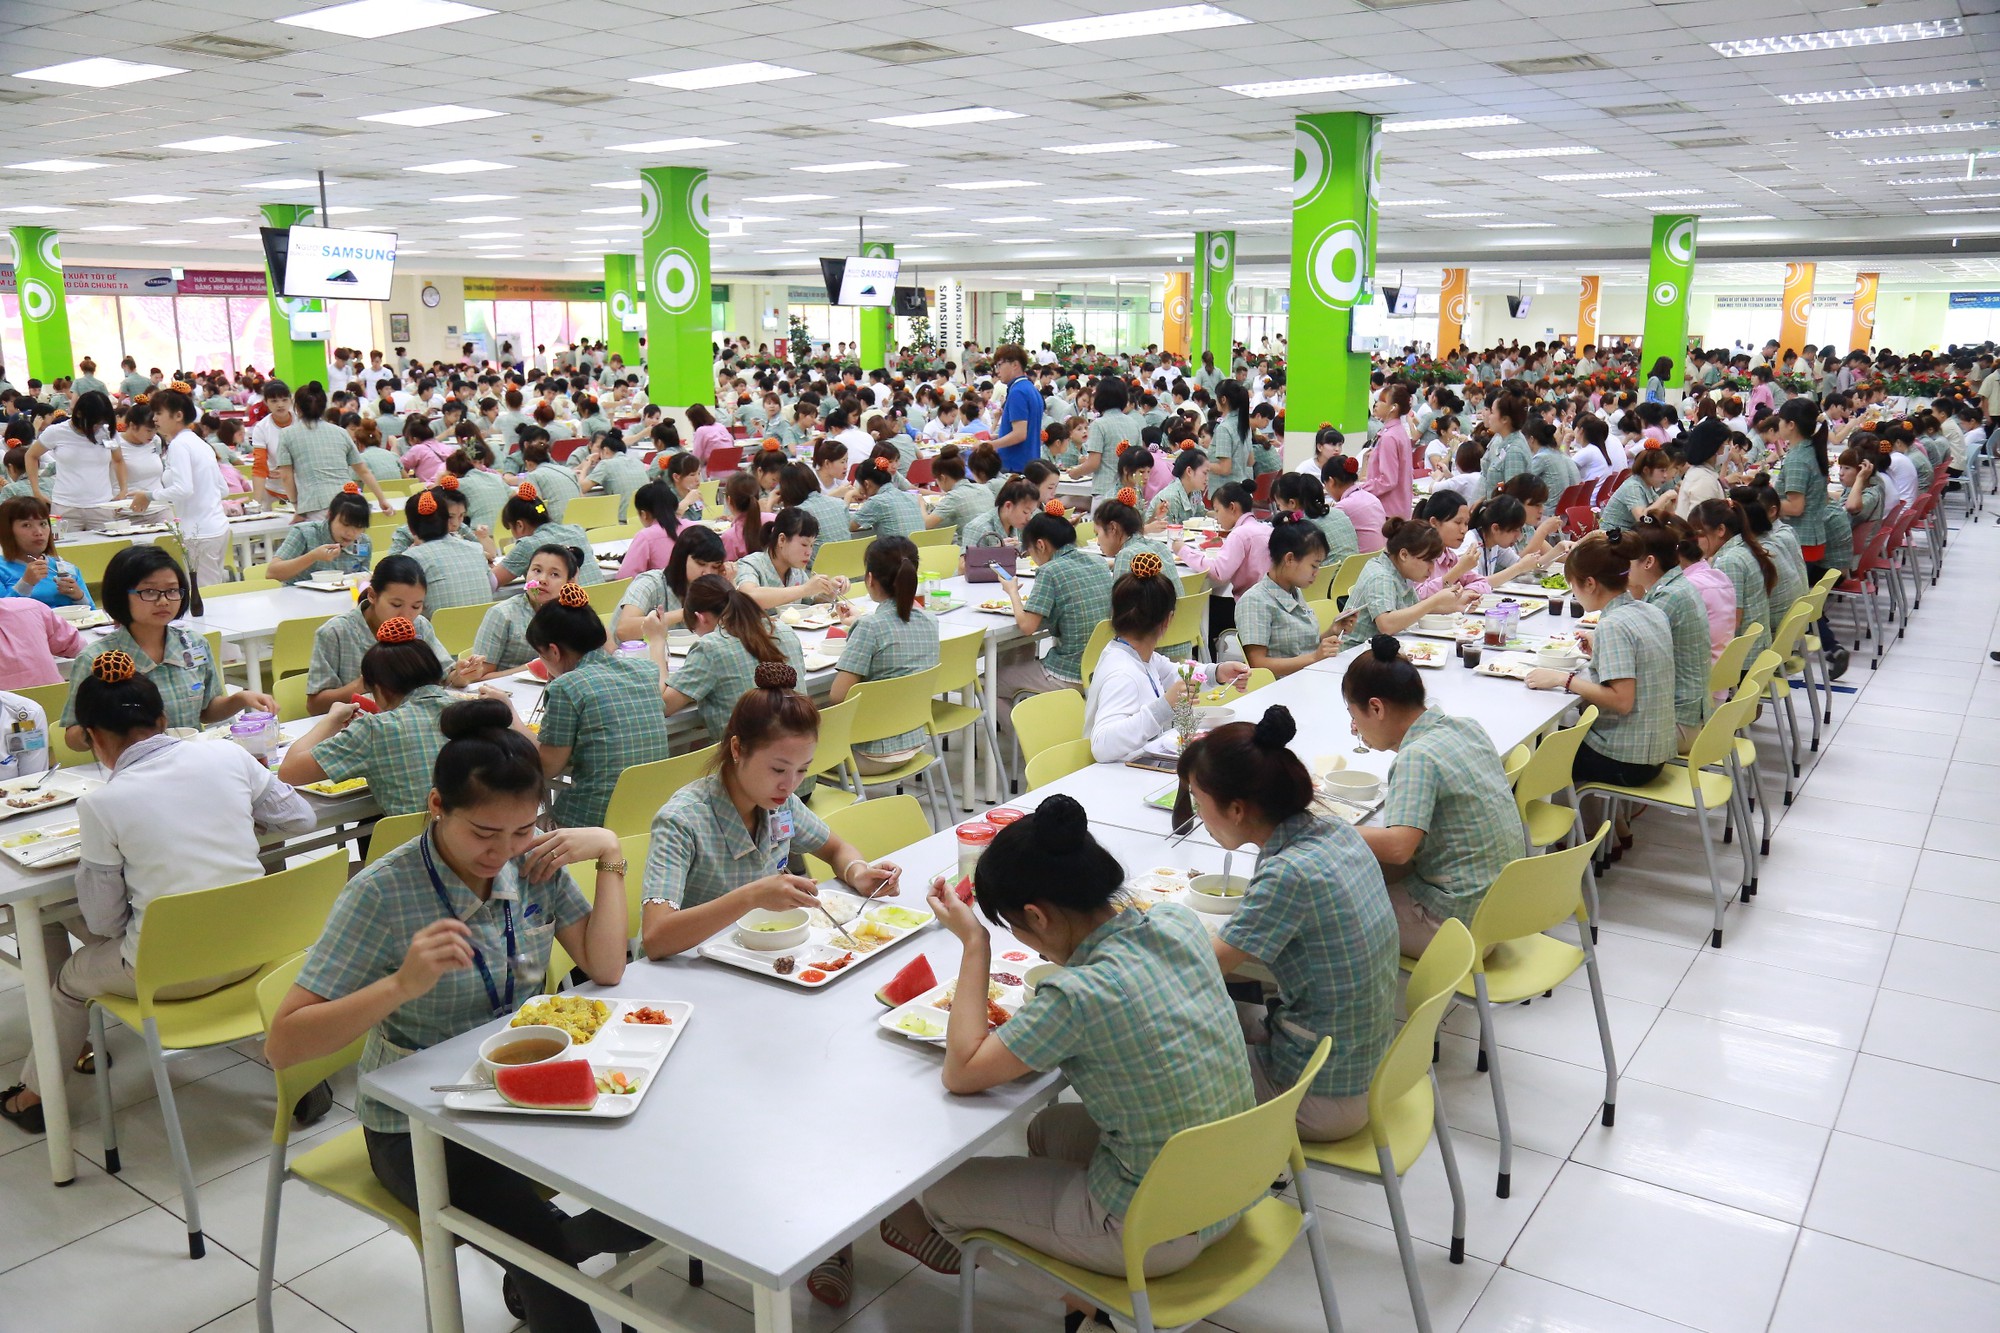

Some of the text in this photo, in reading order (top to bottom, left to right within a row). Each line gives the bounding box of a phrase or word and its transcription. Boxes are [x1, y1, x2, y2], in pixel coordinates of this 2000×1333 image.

[321, 245, 396, 261] SAMSUNG
[860, 268, 899, 280] SAMSUNG
[939, 285, 948, 348] SAMSUNG
